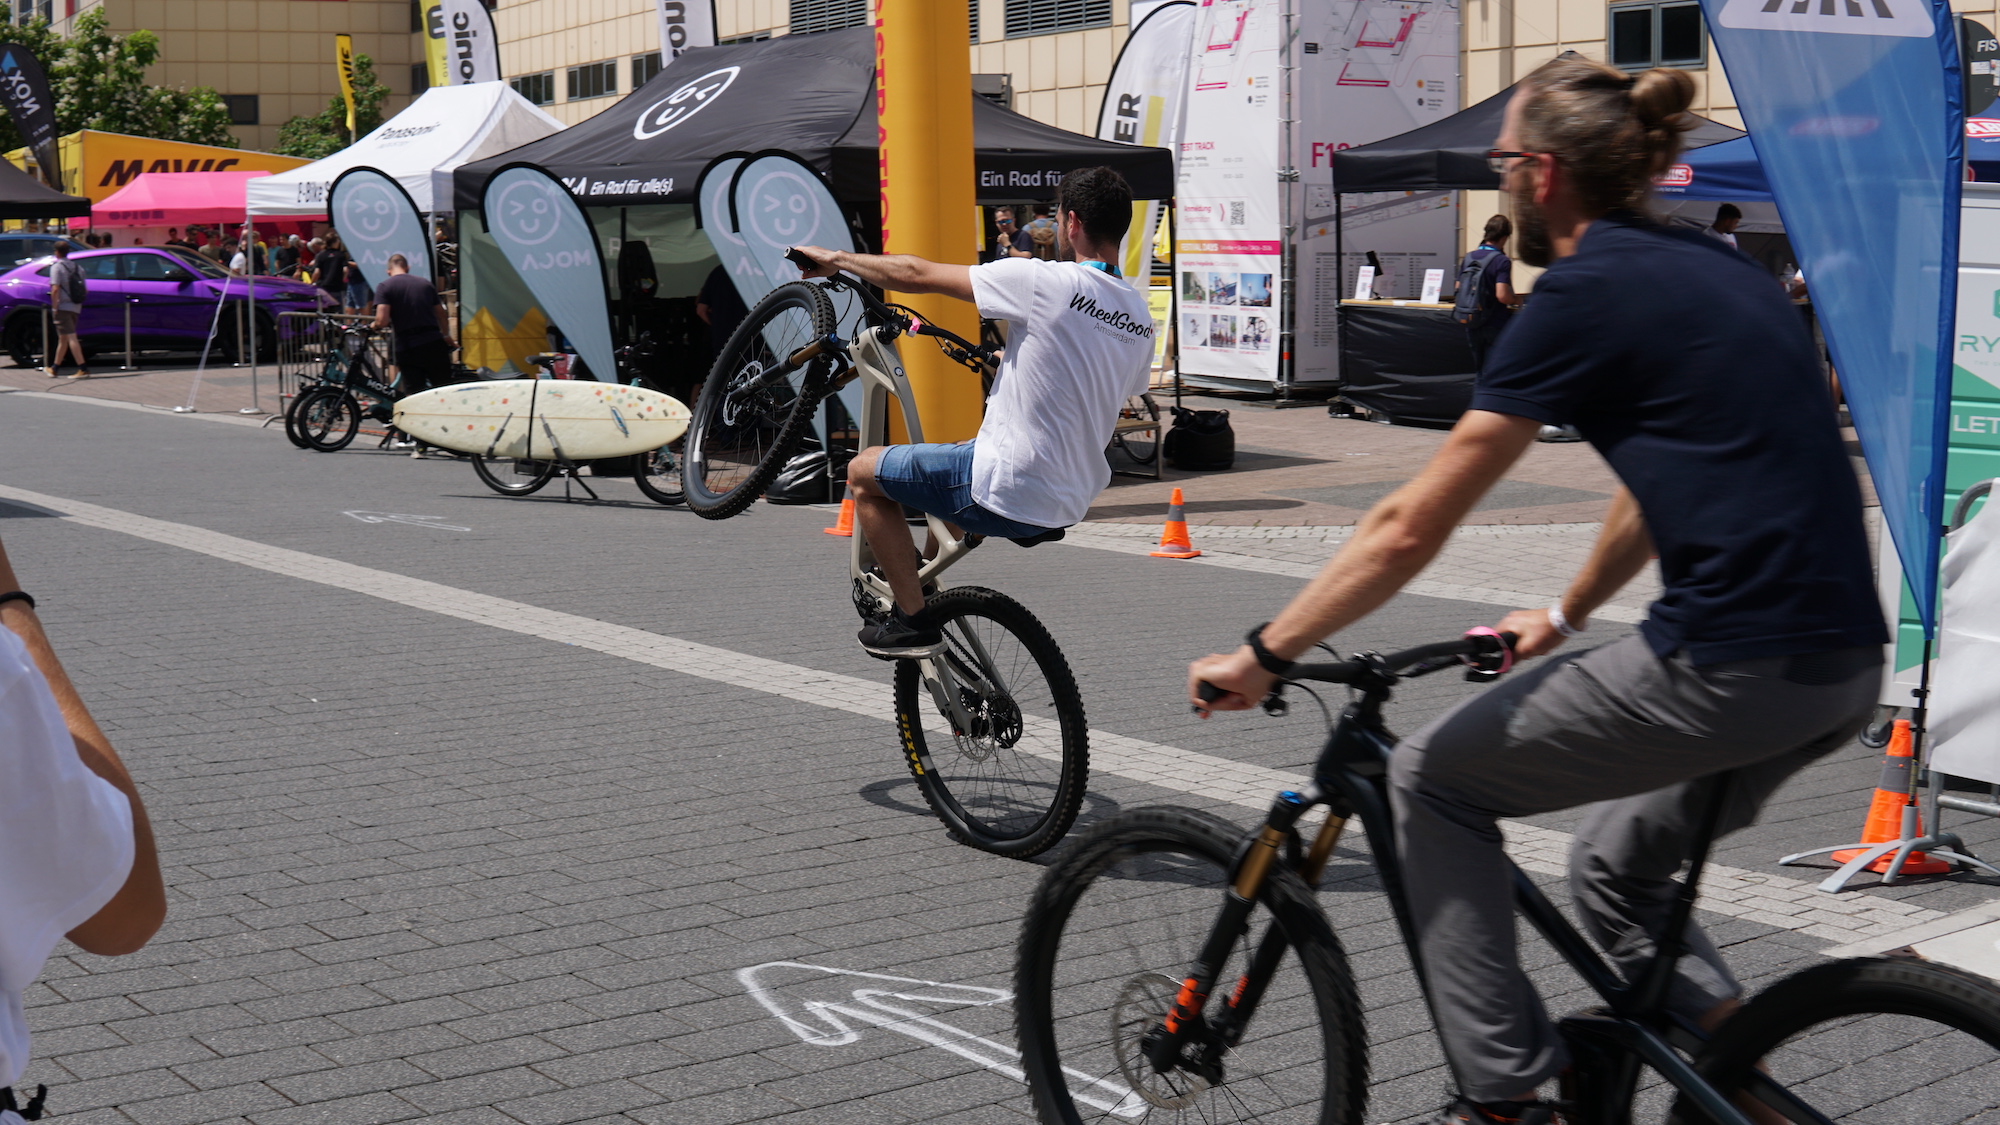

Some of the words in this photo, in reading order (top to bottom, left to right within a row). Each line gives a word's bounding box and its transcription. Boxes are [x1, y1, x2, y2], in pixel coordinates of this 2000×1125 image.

[453, 12, 477, 85] onic
[375, 121, 441, 141] Panasonic
[1312, 142, 1351, 168] F1
[590, 181, 605, 195] Ein
[605, 179, 627, 195] Rad
[626, 179, 642, 195] für
[981, 171, 1004, 187] Ein
[1008, 170, 1041, 187] Rad
[297, 181, 323, 203] E-Bike
[1069, 292, 1152, 340] WheelGood
[1094, 322, 1135, 346] Amsterdam
[901, 713, 925, 775] MAXXIS
